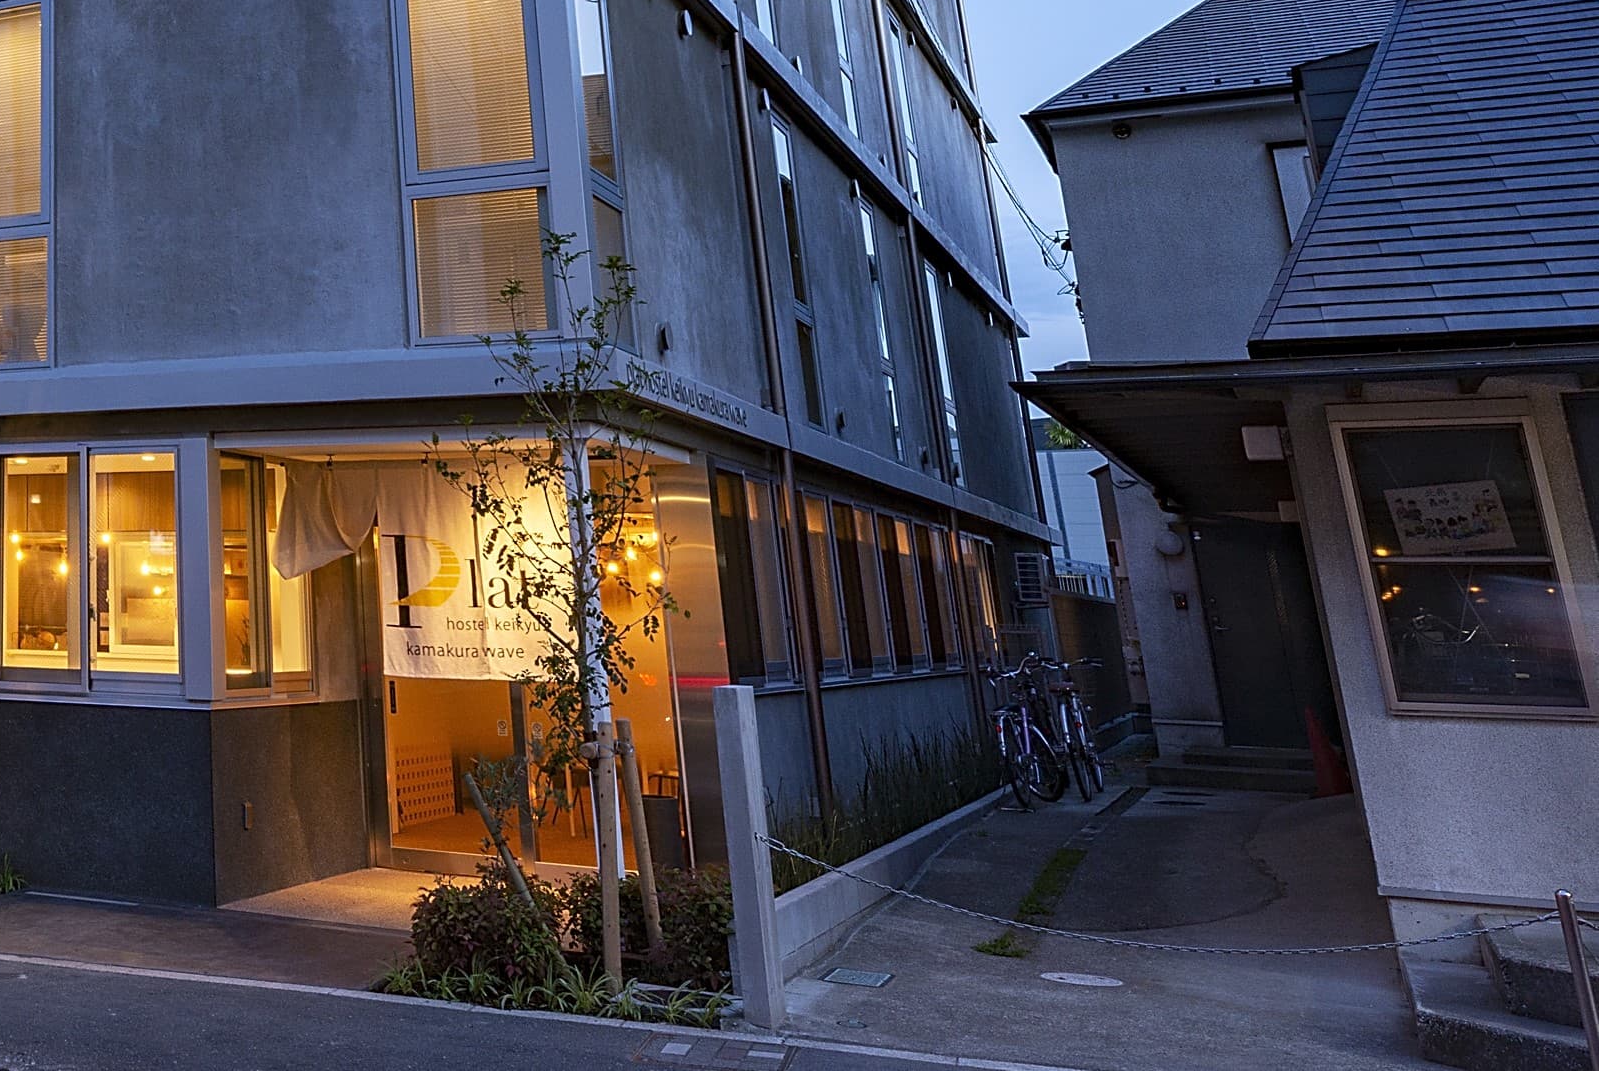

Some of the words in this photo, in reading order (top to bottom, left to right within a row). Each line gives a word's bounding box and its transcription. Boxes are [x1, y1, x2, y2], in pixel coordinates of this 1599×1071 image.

[381, 533, 539, 629] Plat
[446, 616, 490, 632] hostel
[495, 618, 540, 634] keikyu
[406, 642, 479, 659] kamakura
[482, 647, 525, 659] wave
